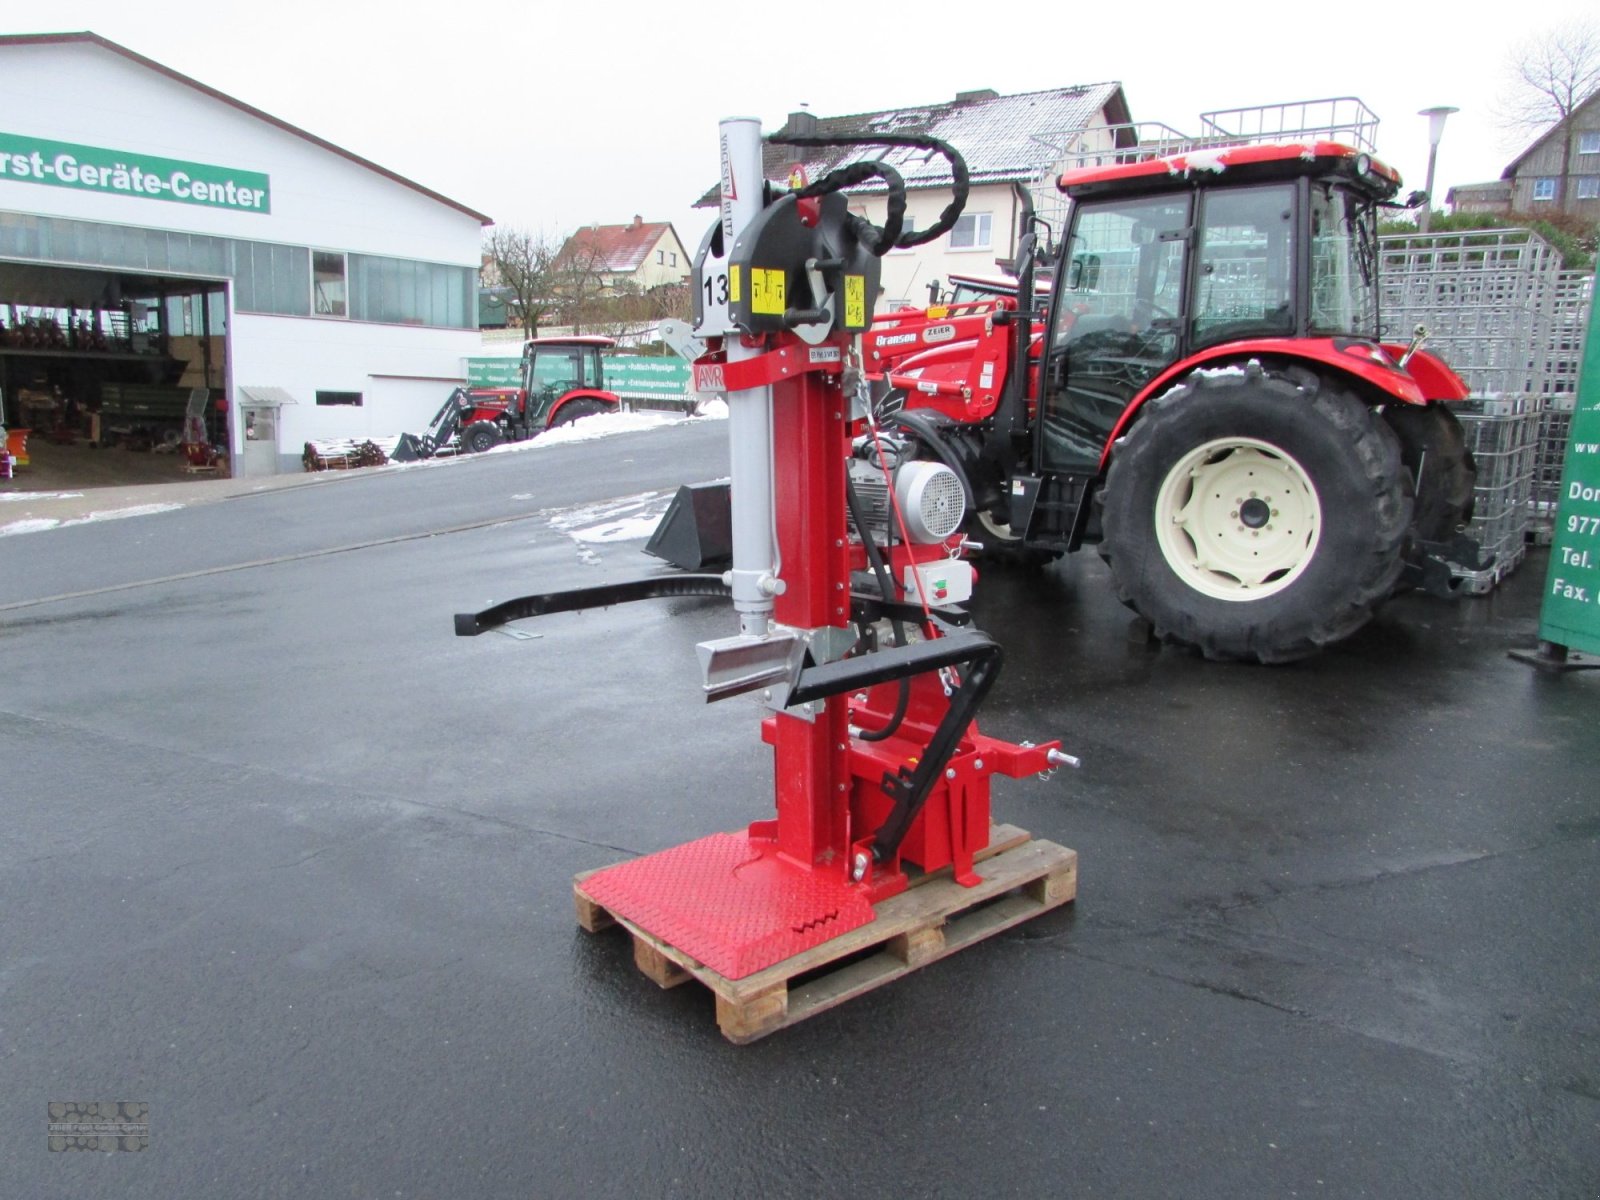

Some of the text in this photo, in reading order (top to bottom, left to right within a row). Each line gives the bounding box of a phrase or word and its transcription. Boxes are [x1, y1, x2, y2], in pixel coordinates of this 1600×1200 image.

[876, 333, 917, 347] Branson
[1561, 546, 1592, 569] Tel.
[1552, 578, 1590, 603] Fax.
